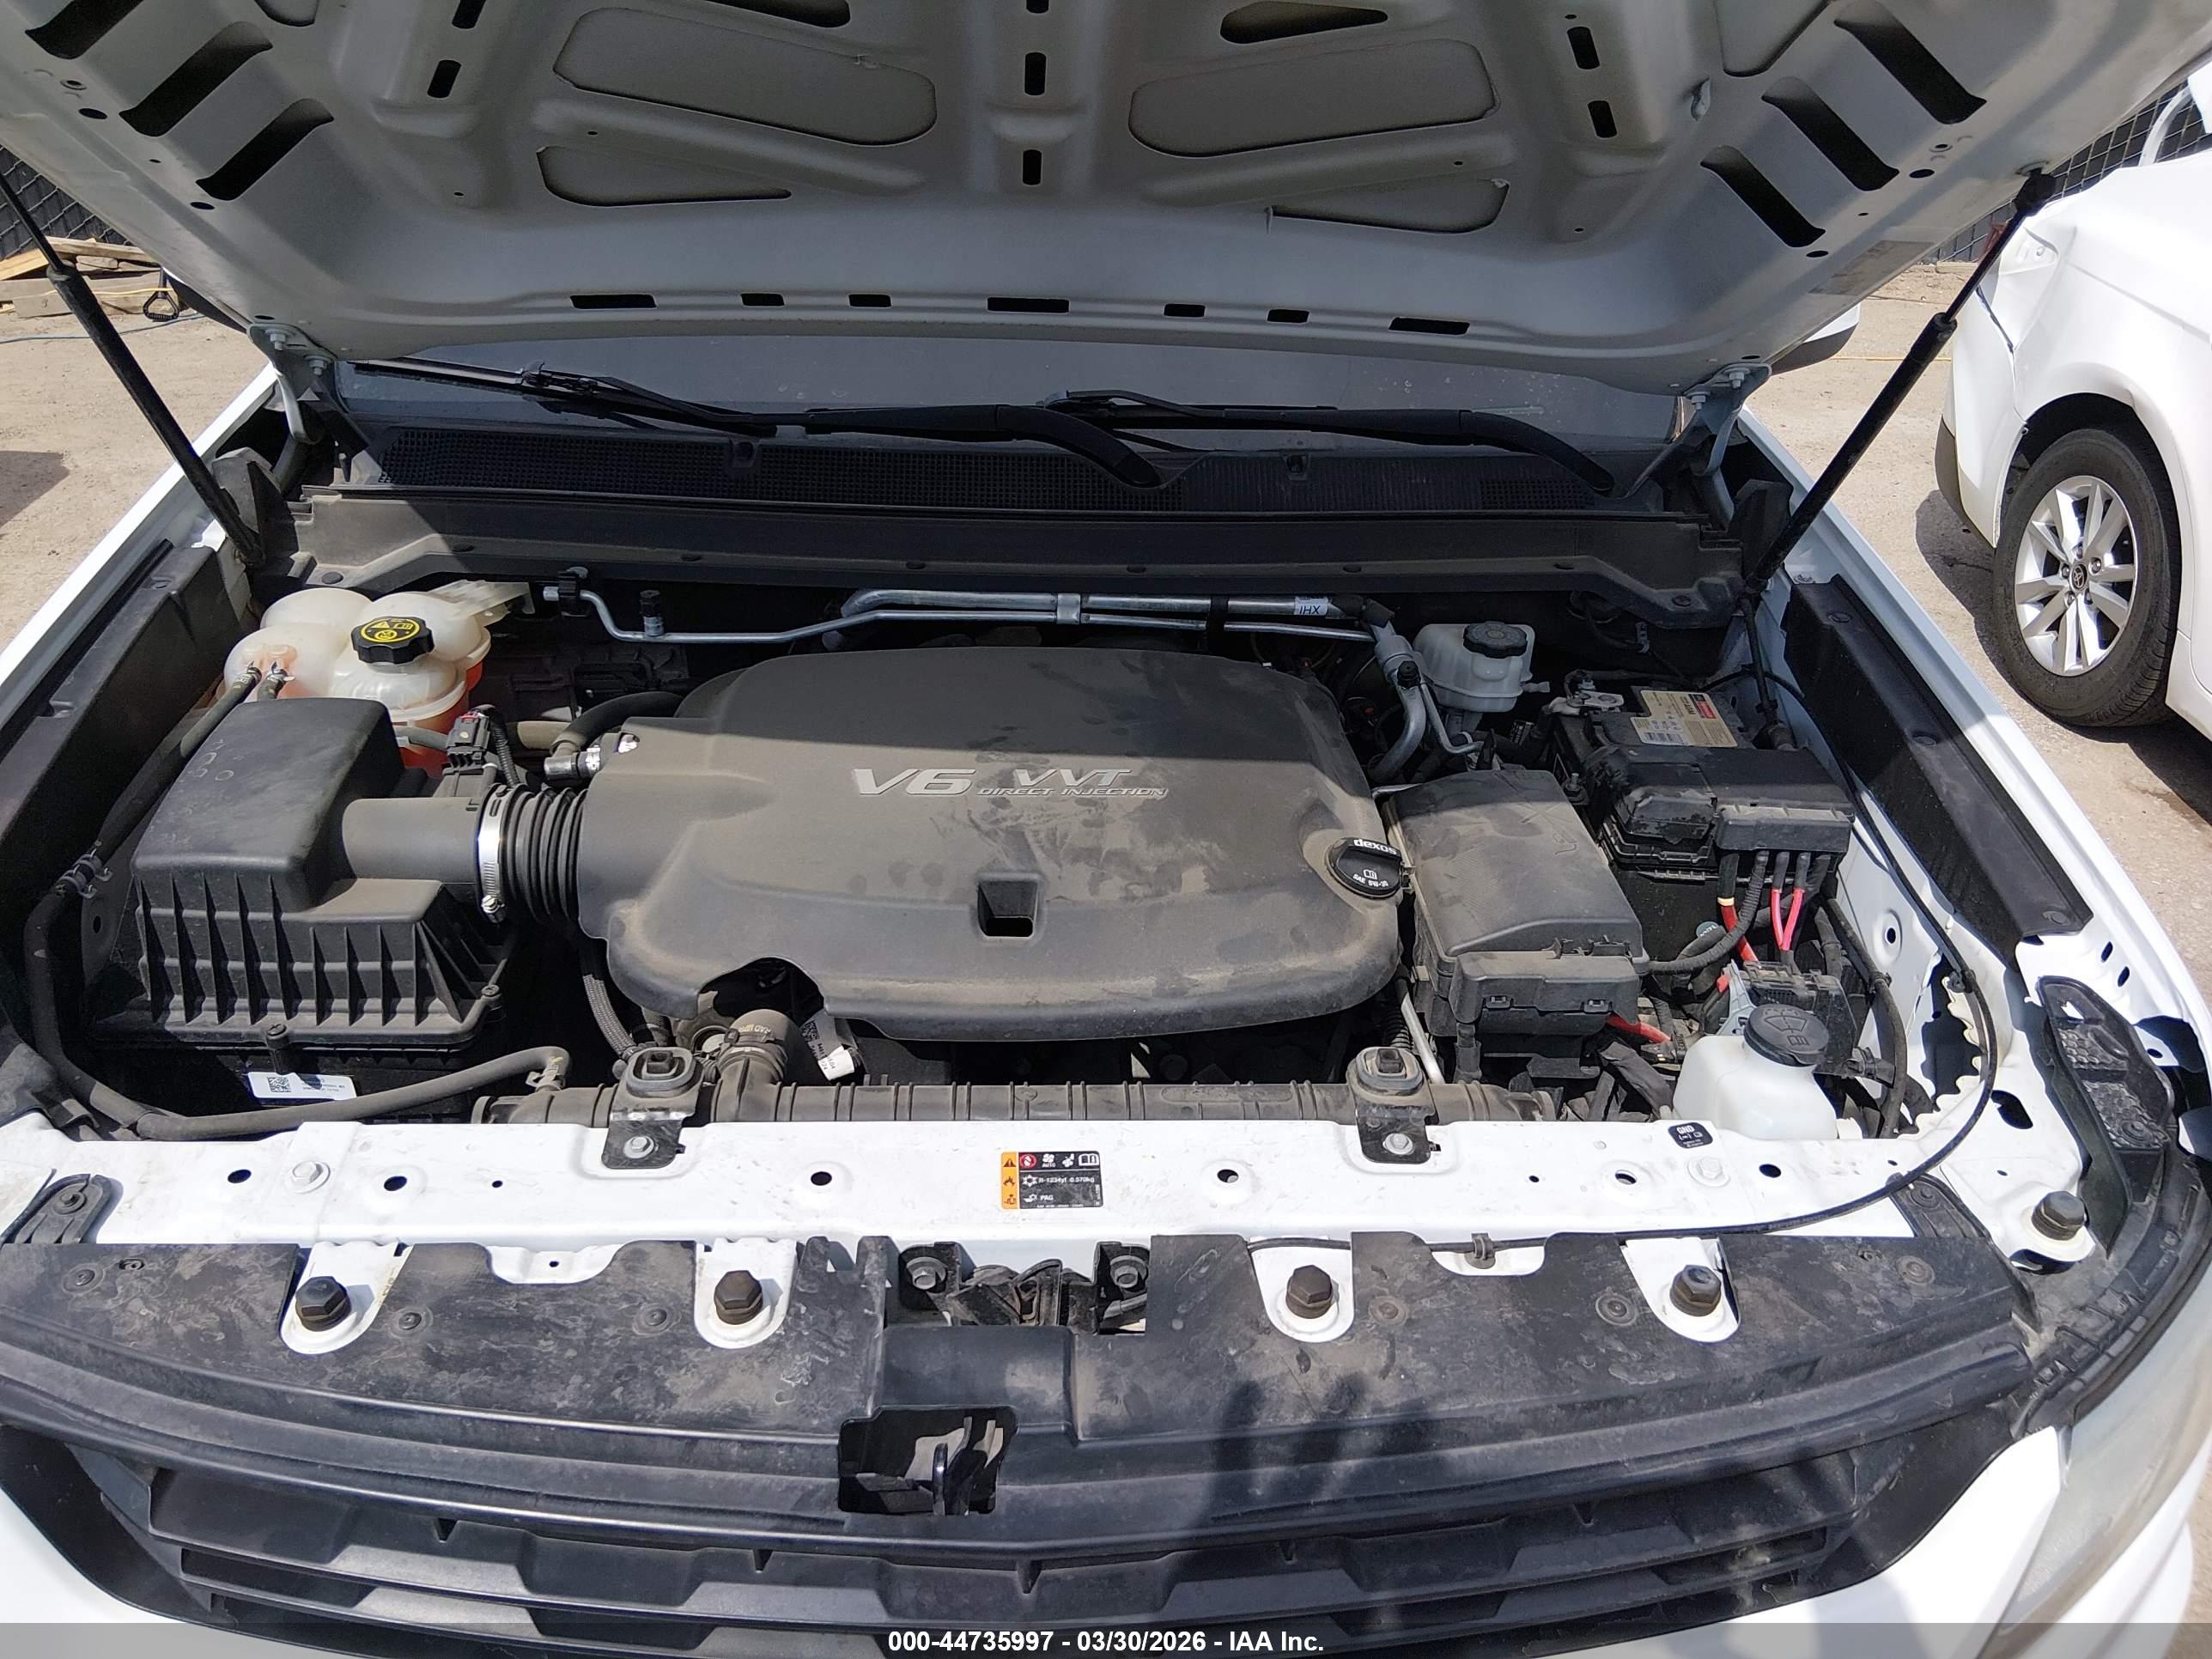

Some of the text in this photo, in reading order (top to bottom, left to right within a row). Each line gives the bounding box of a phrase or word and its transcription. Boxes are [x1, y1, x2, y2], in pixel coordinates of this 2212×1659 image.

[854, 769, 1132, 796] V6 VVT
[976, 787, 1169, 798] DIRECT INJECTION
[1353, 839, 1397, 855] dexos
[1352, 873, 1366, 884] SAE
[754, 1024, 772, 1034] RAD
[1676, 1125, 1695, 1134] GND
